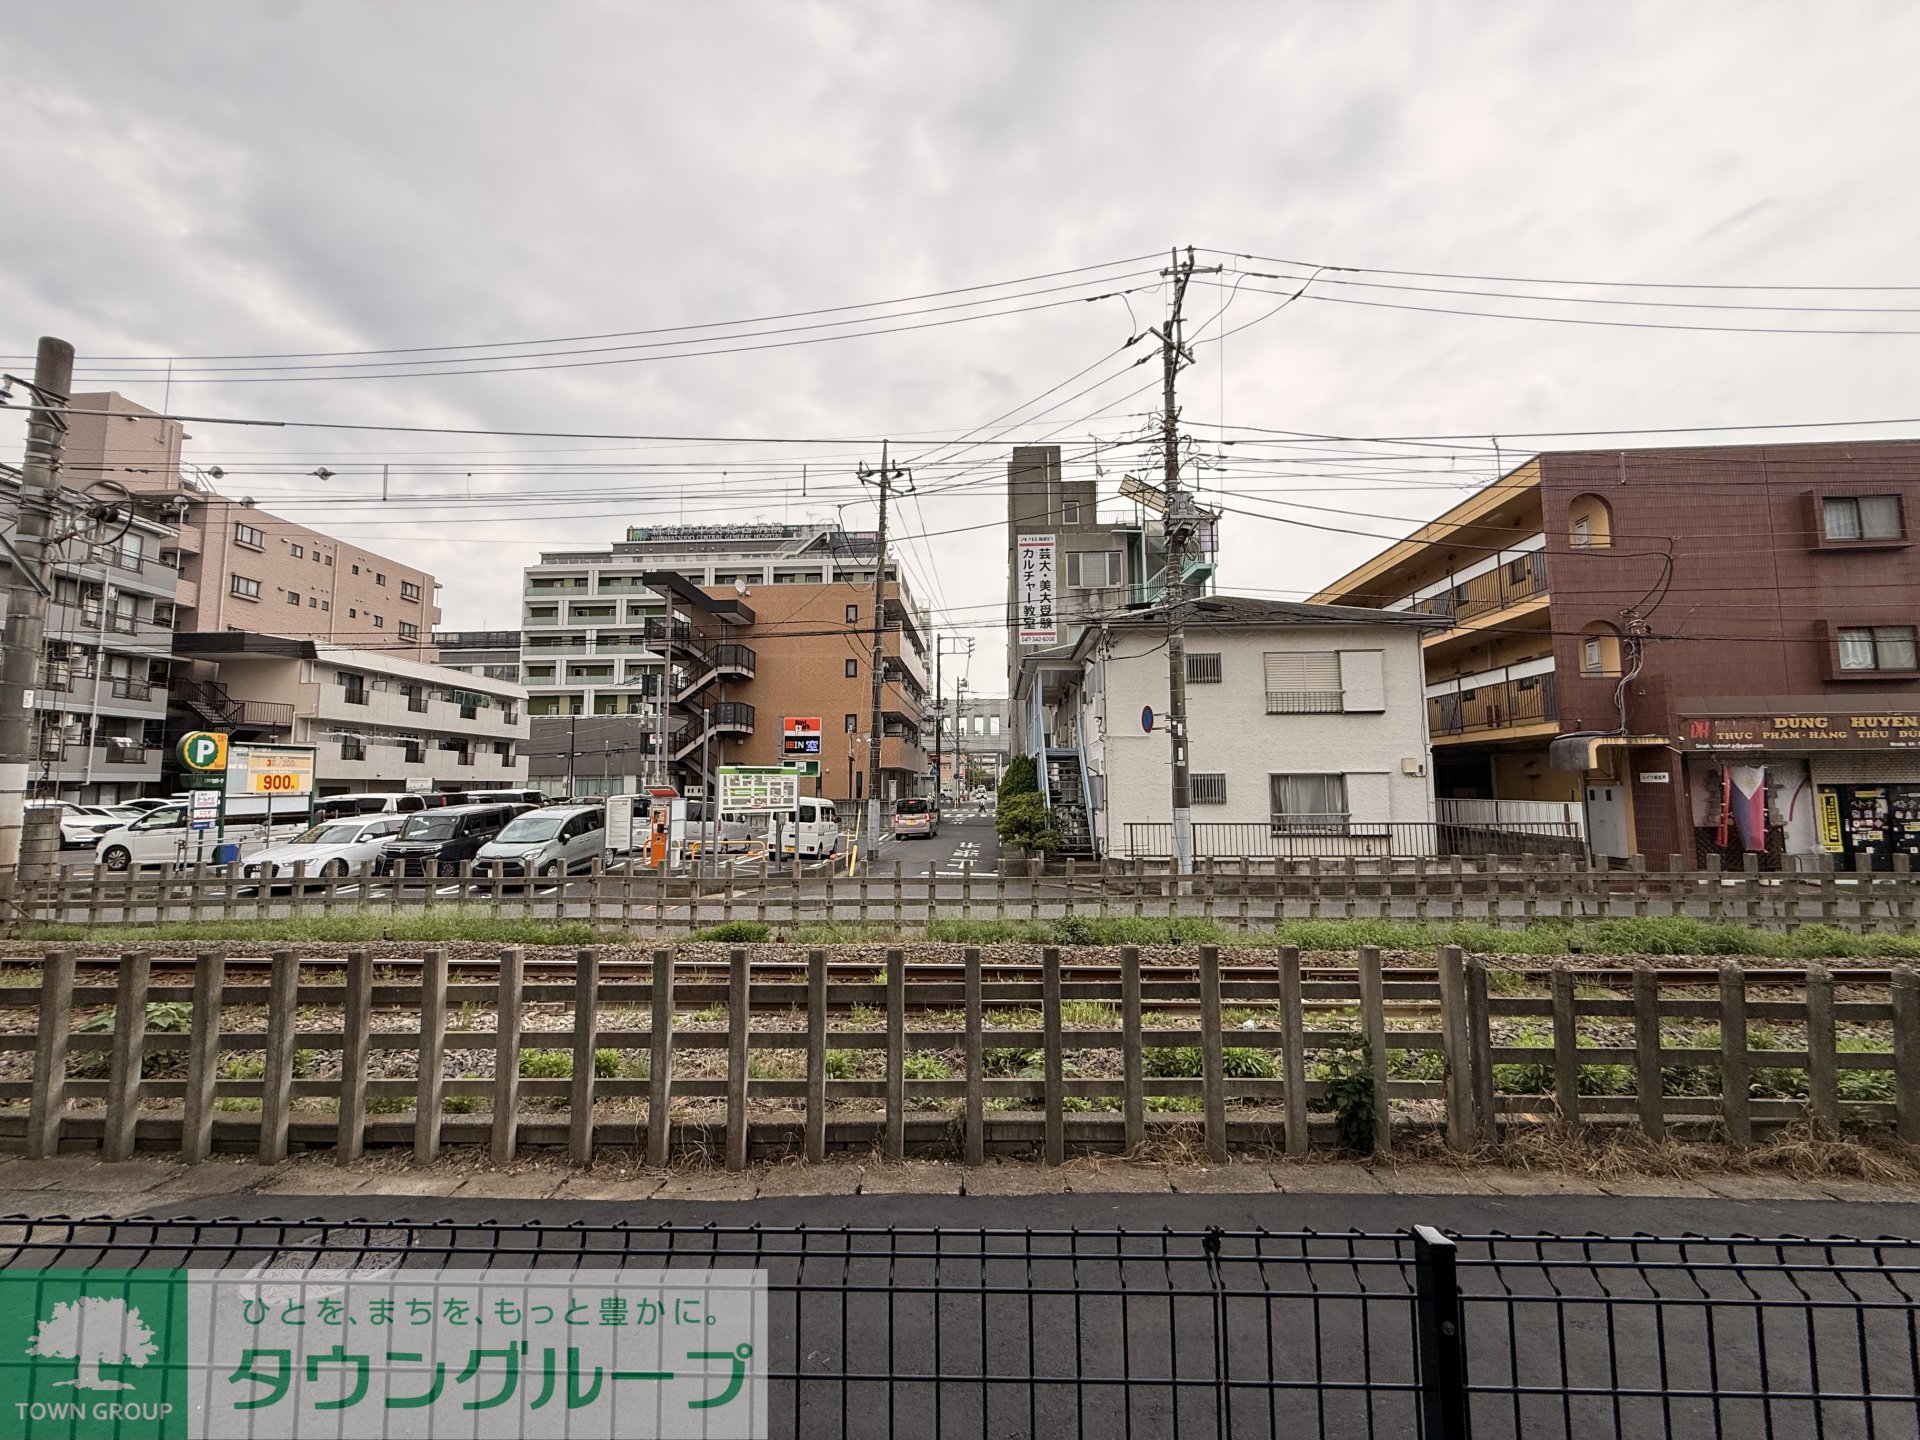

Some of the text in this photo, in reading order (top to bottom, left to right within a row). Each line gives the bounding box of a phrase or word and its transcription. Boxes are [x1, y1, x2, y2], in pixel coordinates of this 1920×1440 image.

[1023, 548, 1036, 630] カルチャー教室
[1039, 548, 1053, 629] 芸大・美大受験
